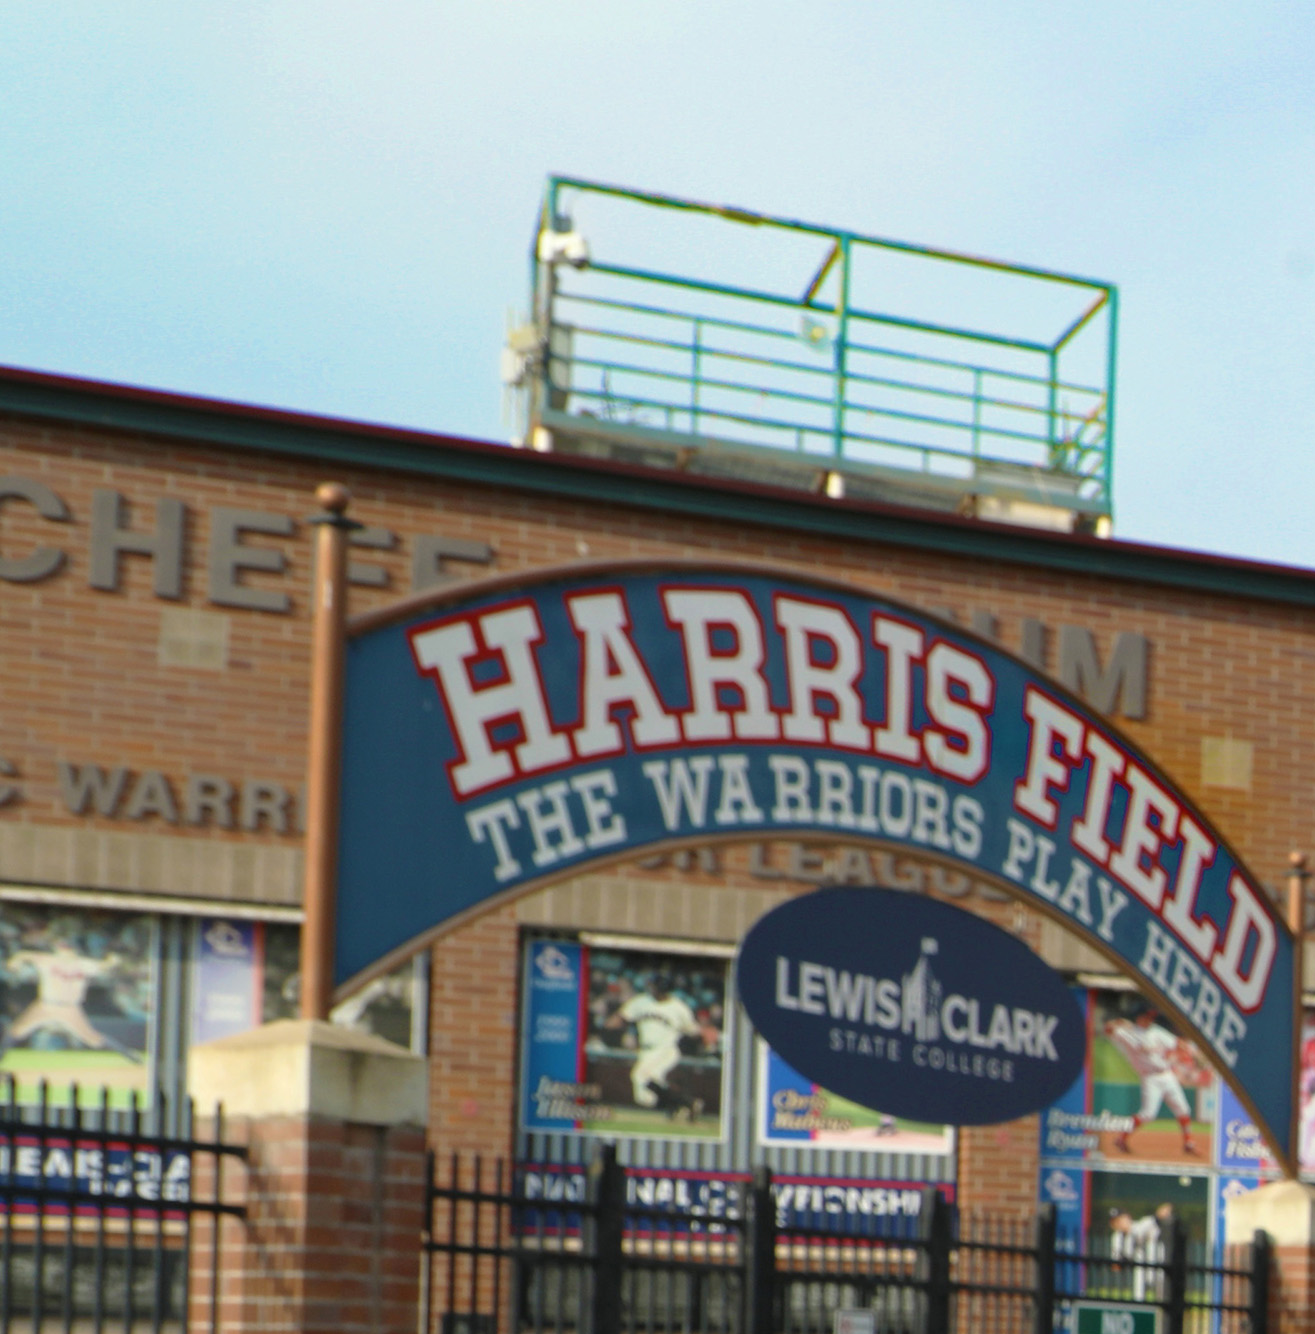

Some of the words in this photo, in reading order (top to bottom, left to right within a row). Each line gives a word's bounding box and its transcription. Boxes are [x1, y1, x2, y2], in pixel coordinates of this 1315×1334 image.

[57, 762, 307, 834] WARR
[407, 584, 995, 802] HARRIS
[1013, 682, 1279, 1015] FIELD
[466, 769, 627, 882] THE
[643, 754, 985, 860] WARRIORS
[1000, 819, 1129, 943] PLAY
[1138, 921, 1248, 1068] HERE
[774, 955, 902, 1031] LEWIS
[940, 1001, 1059, 1061] CLARK
[828, 1028, 907, 1059] STATE
[912, 1045, 1015, 1084] COLLEGE
